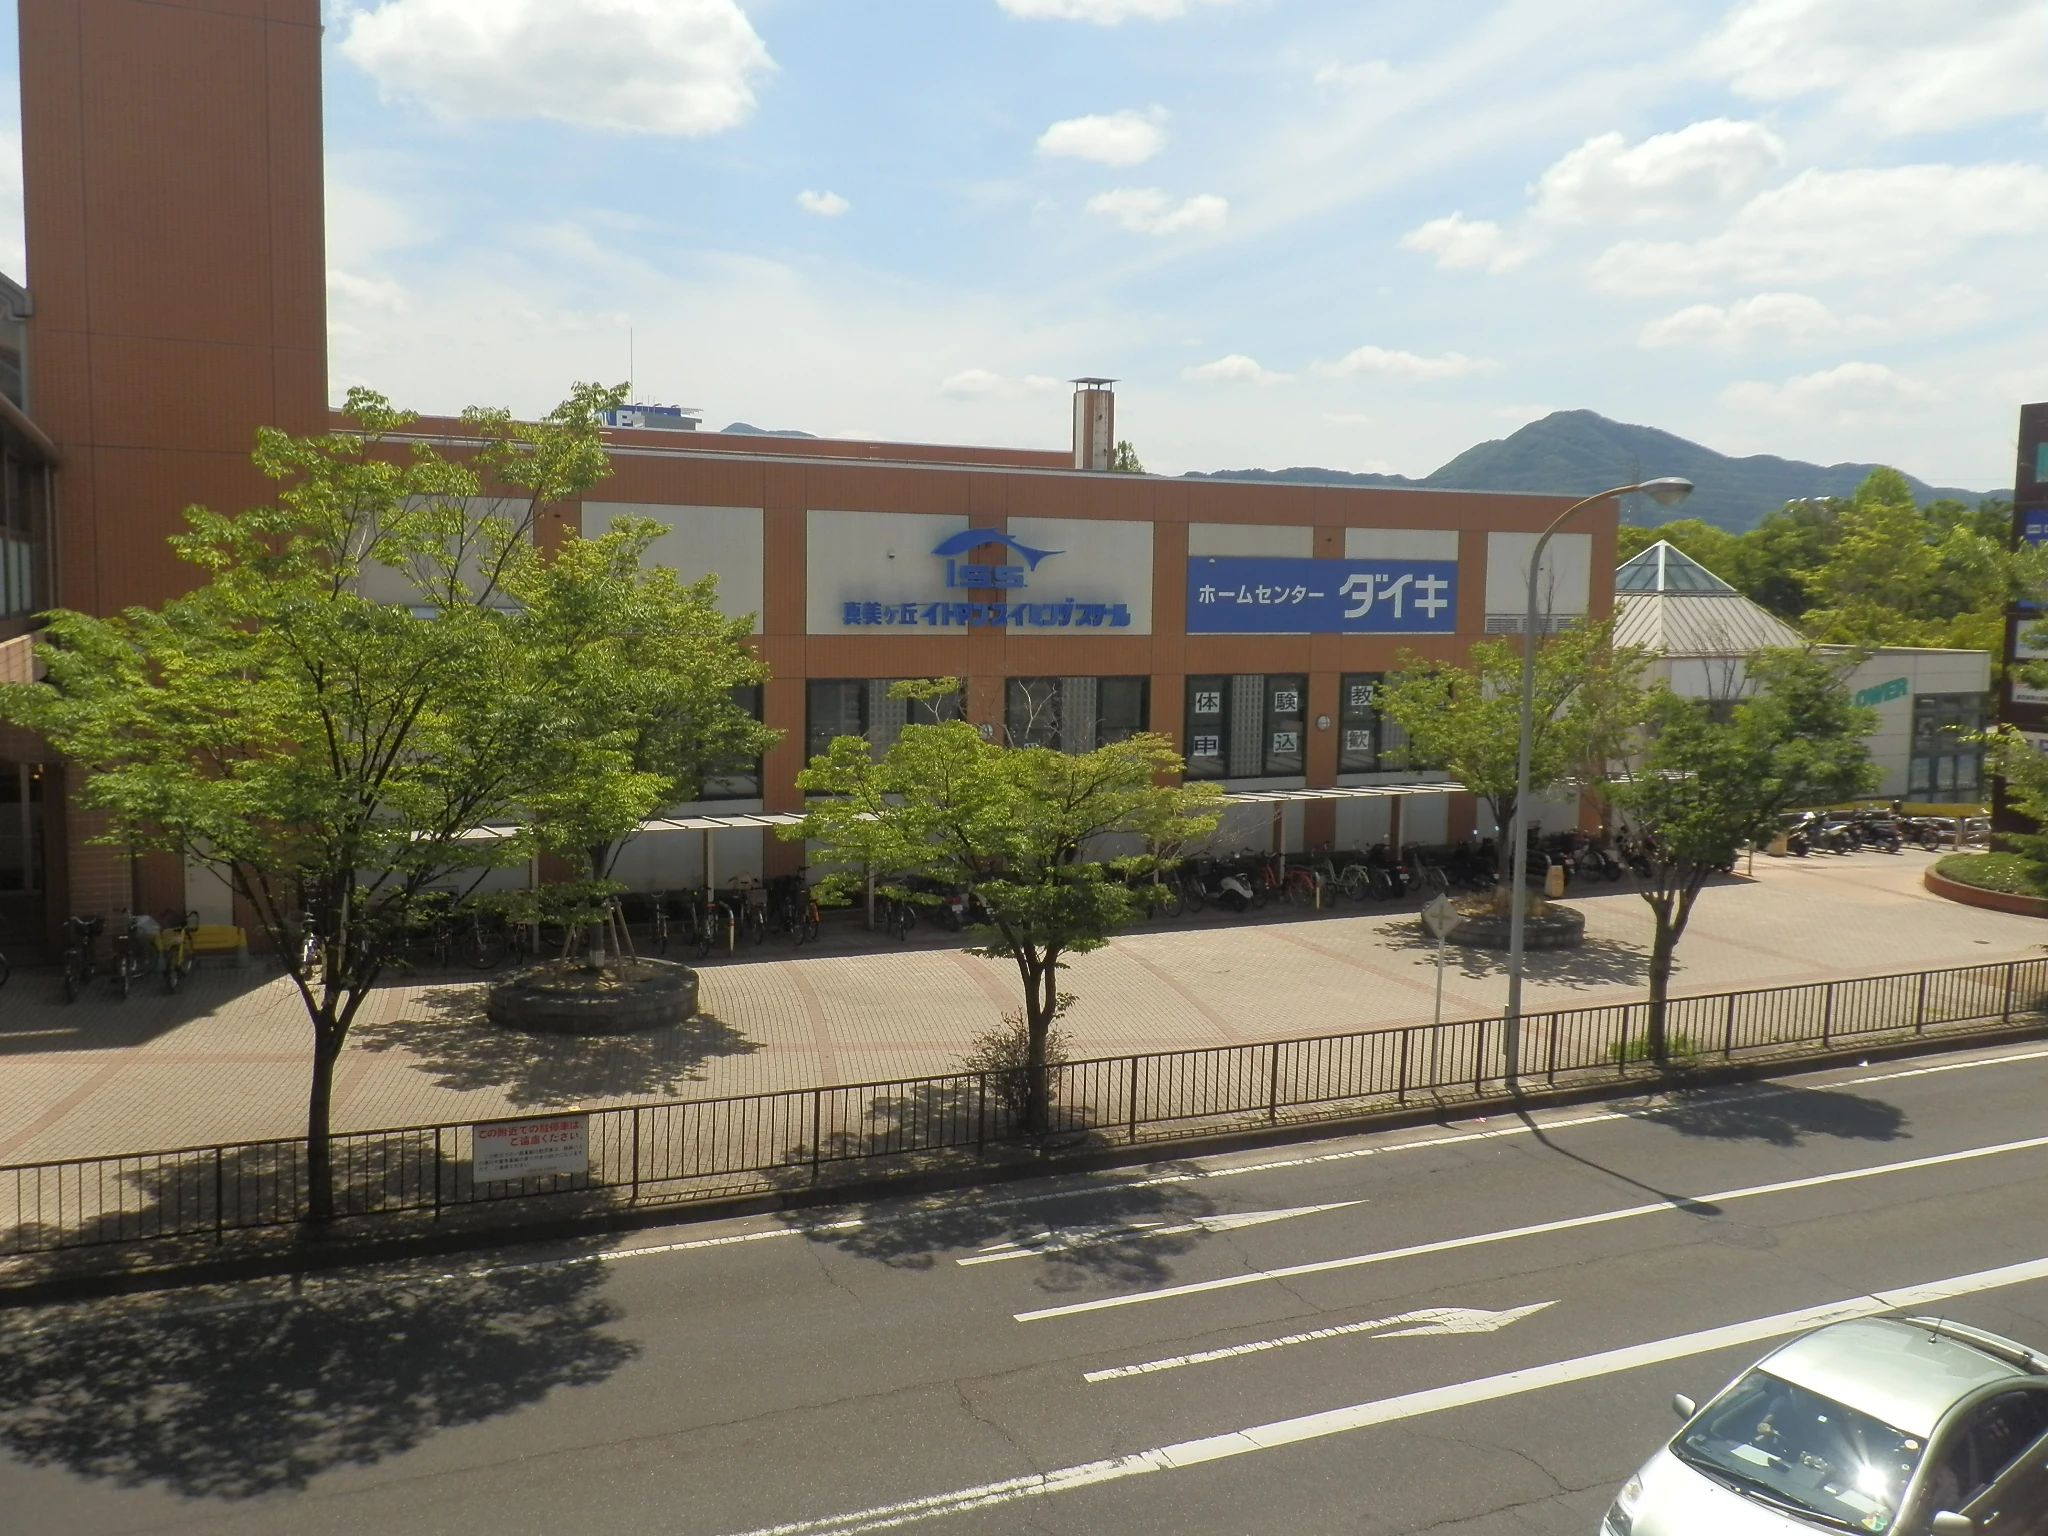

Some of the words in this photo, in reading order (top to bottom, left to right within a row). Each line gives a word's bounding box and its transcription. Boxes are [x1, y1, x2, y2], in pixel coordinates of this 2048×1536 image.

[1199, 584, 1325, 605] ホームセンター
[1339, 573, 1449, 619] ダイキ
[1196, 692, 1219, 712] 体
[1275, 691, 1297, 711] 験
[1352, 685, 1372, 705] 教
[1854, 676, 1909, 708] OWER
[1194, 736, 1217, 755] 申
[1275, 733, 1296, 751] 込
[1348, 730, 1369, 749] 歓
